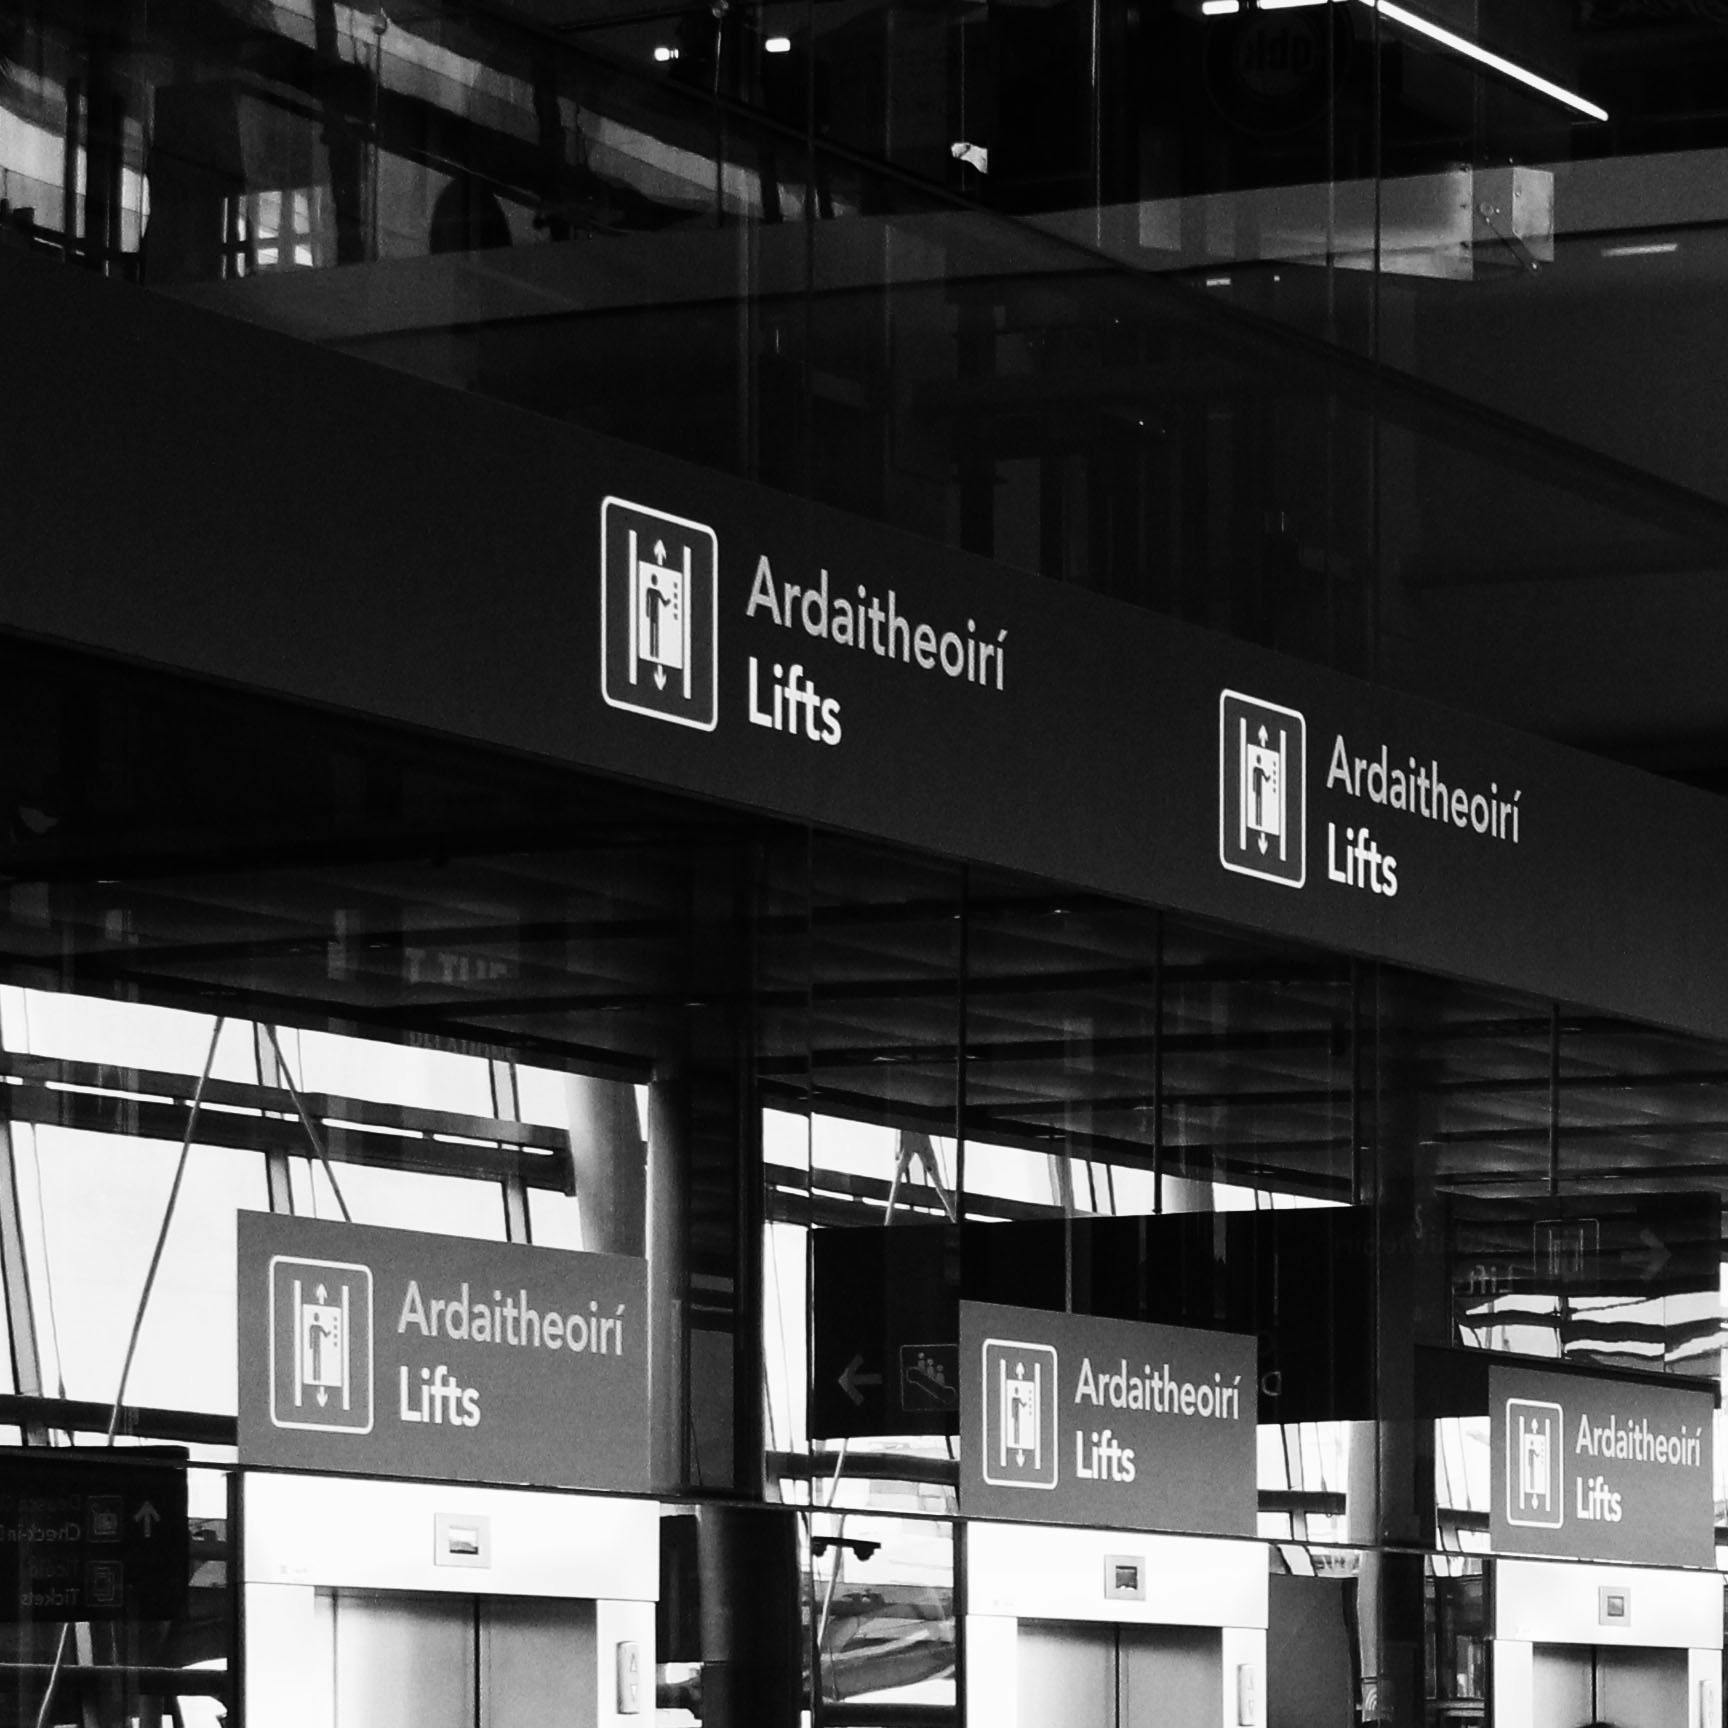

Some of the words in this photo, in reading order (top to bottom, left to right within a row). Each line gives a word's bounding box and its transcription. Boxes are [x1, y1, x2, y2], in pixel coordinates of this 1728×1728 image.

[746, 554, 1006, 691] Ardaitheoirí
[748, 656, 842, 746] Lifts
[1326, 734, 1519, 843] Ardaitheoirí
[1328, 823, 1398, 898] Lifts
[397, 1281, 625, 1356] Ardaitheoirí
[400, 1366, 481, 1428] Lifts
[1074, 1357, 1240, 1420] Ardaitheoirí
[1076, 1430, 1136, 1484] Lifts
[1576, 1413, 1703, 1467] Ardaitheoirí
[1576, 1476, 1623, 1524] Lifts
